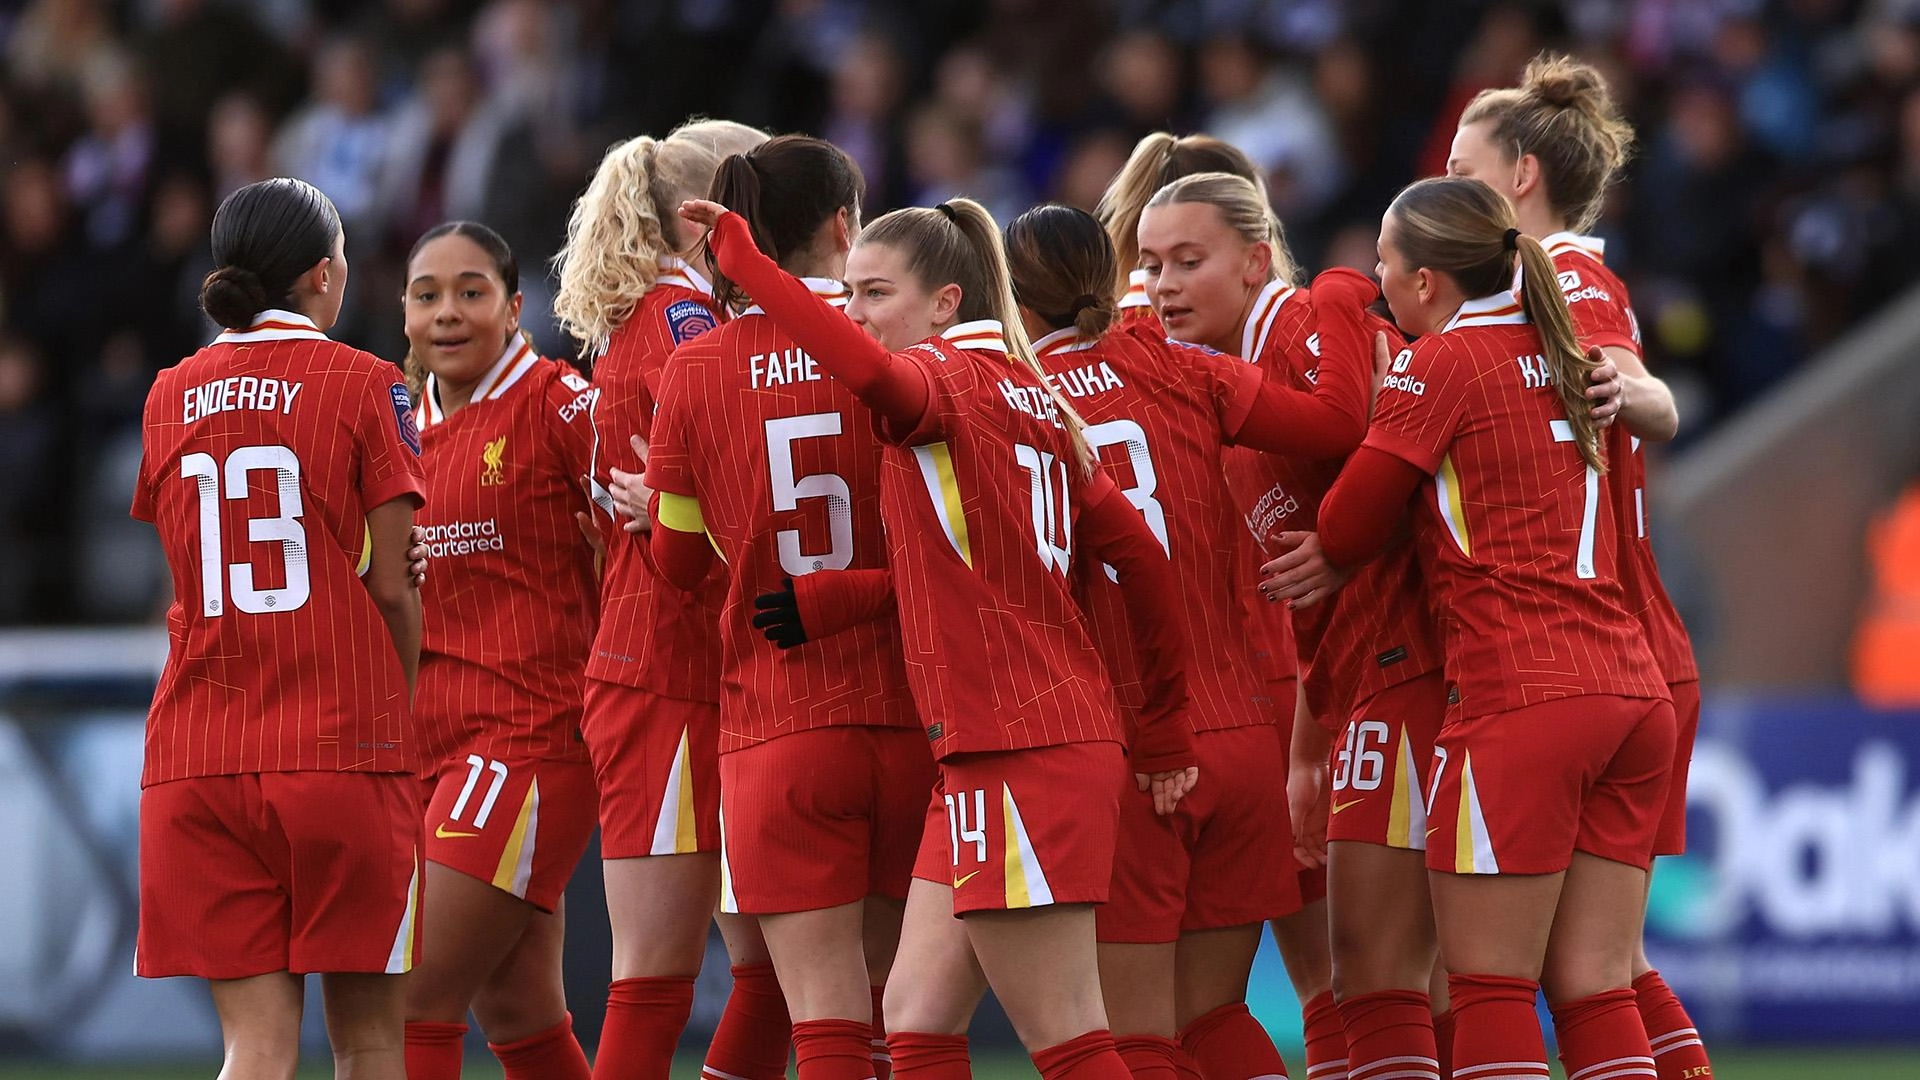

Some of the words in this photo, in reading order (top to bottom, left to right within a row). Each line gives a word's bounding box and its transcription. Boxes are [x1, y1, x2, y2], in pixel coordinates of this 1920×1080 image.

[183, 376, 302, 425] ENDERBY
[750, 347, 834, 389] FAHE
[413, 518, 496, 541] andard
[765, 412, 854, 577] 5
[1549, 420, 1597, 579] 7
[181, 445, 310, 618] 13
[418, 534, 504, 558] hartered
[1332, 720, 1389, 791] 36
[1426, 745, 1448, 816] 7
[450, 754, 508, 829] 11
[944, 789, 987, 866] 14
